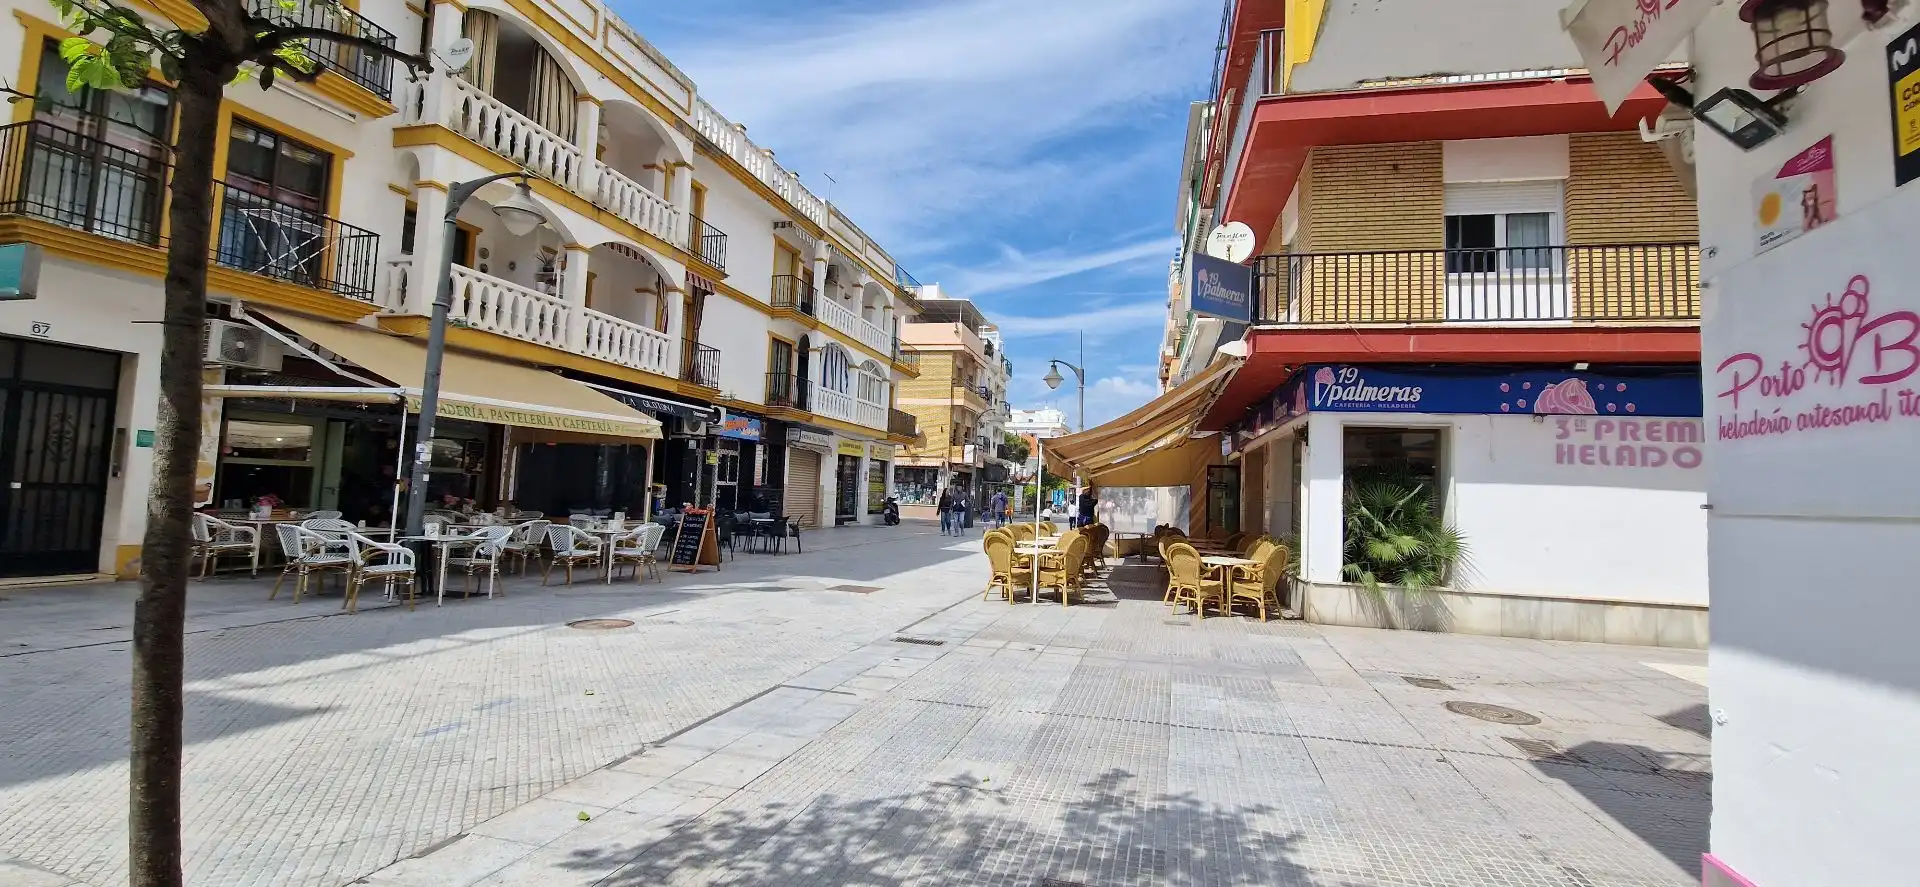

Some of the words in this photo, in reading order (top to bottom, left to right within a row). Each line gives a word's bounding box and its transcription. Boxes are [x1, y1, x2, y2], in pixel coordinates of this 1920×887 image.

[1209, 272, 1219, 285] 19
[1203, 281, 1245, 303] palmeras
[32, 323, 50, 334] 67
[1338, 367, 1358, 384] 19
[1716, 352, 1805, 410] Porto
[1326, 378, 1423, 407] palmeras
[412, 398, 488, 420] PADERÍA,
[490, 408, 555, 427] PASTELERÍA
[562, 417, 613, 433] CAFETERÍA
[1719, 407, 1792, 441] heladería
[1797, 388, 1892, 431] artesanal
[1556, 443, 1704, 469] HELADO
